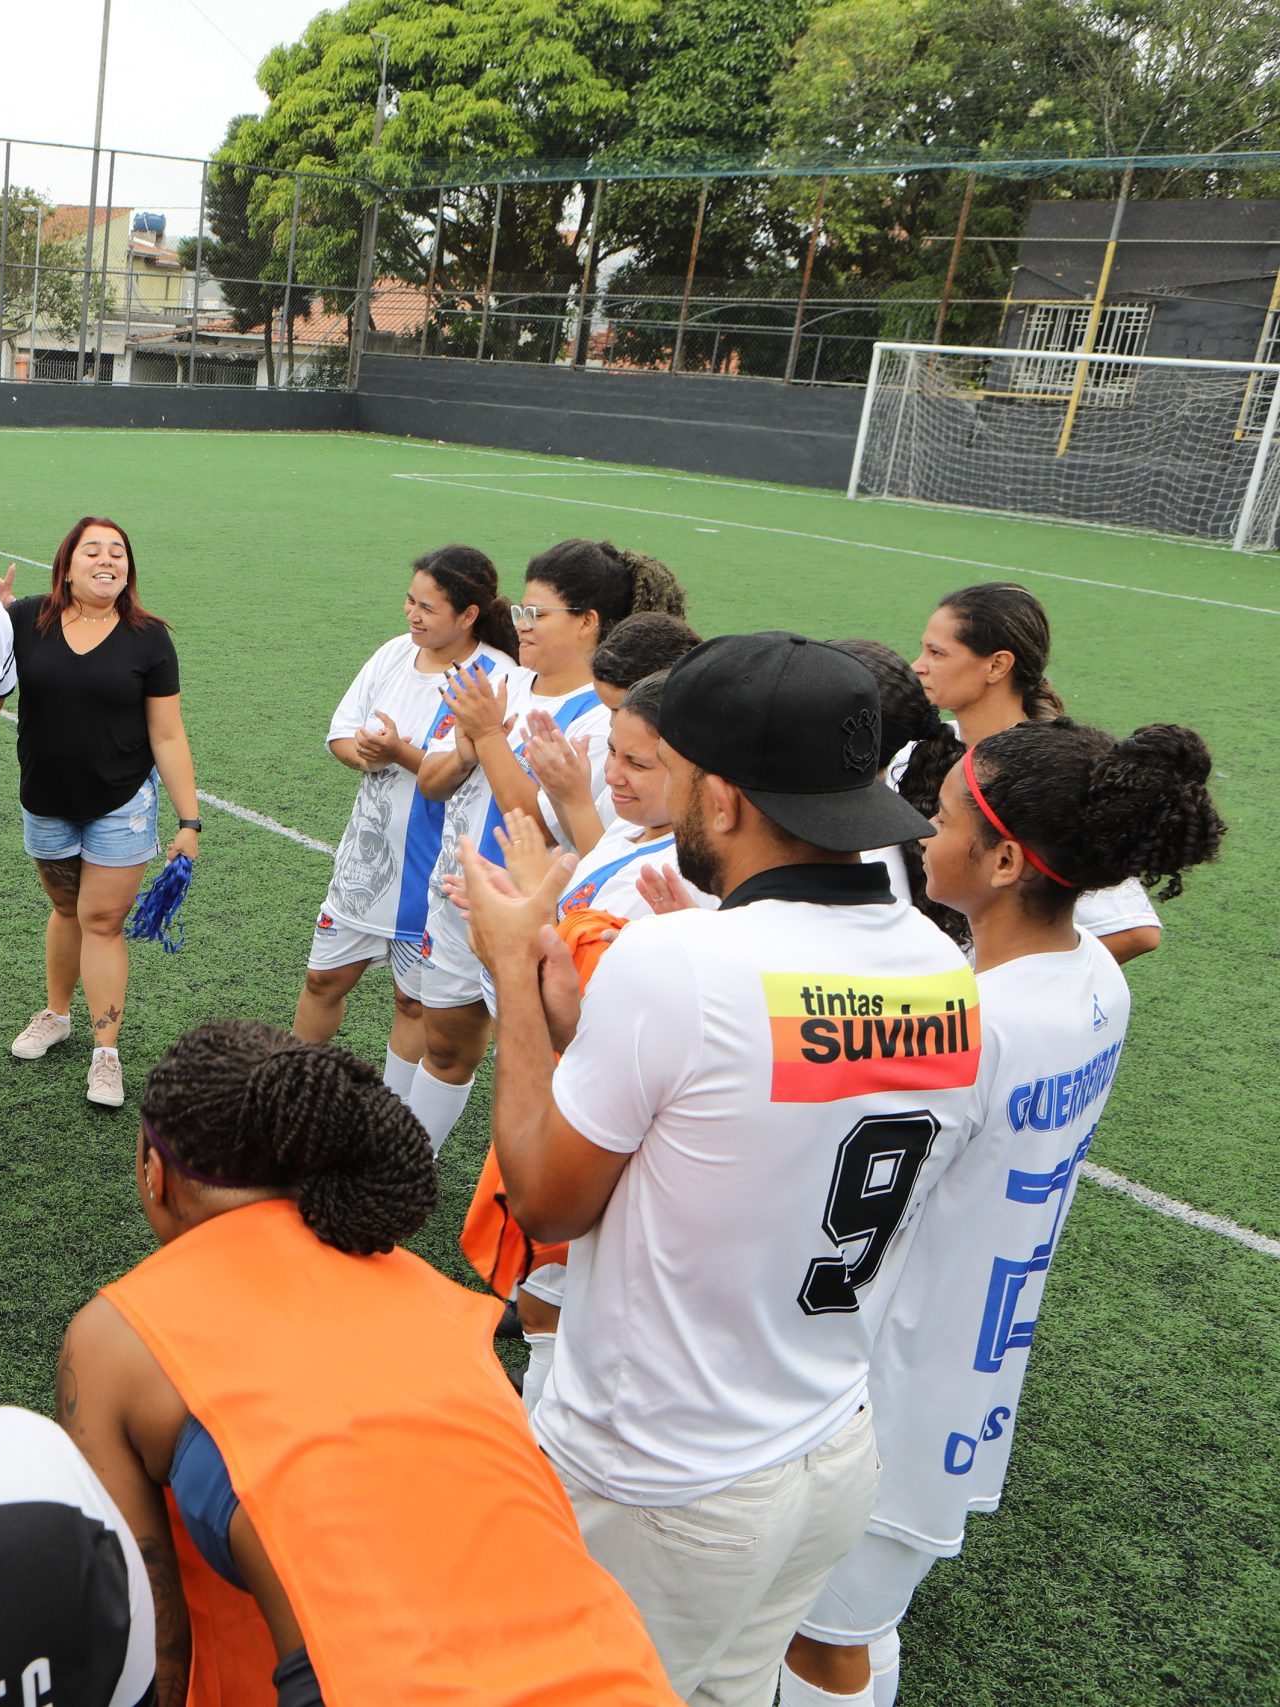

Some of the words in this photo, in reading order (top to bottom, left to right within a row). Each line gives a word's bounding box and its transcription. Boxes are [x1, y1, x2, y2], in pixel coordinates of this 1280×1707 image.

[800, 985, 884, 1017] tintas
[800, 998, 969, 1065] suvinil
[797, 1109, 942, 1316] 9
